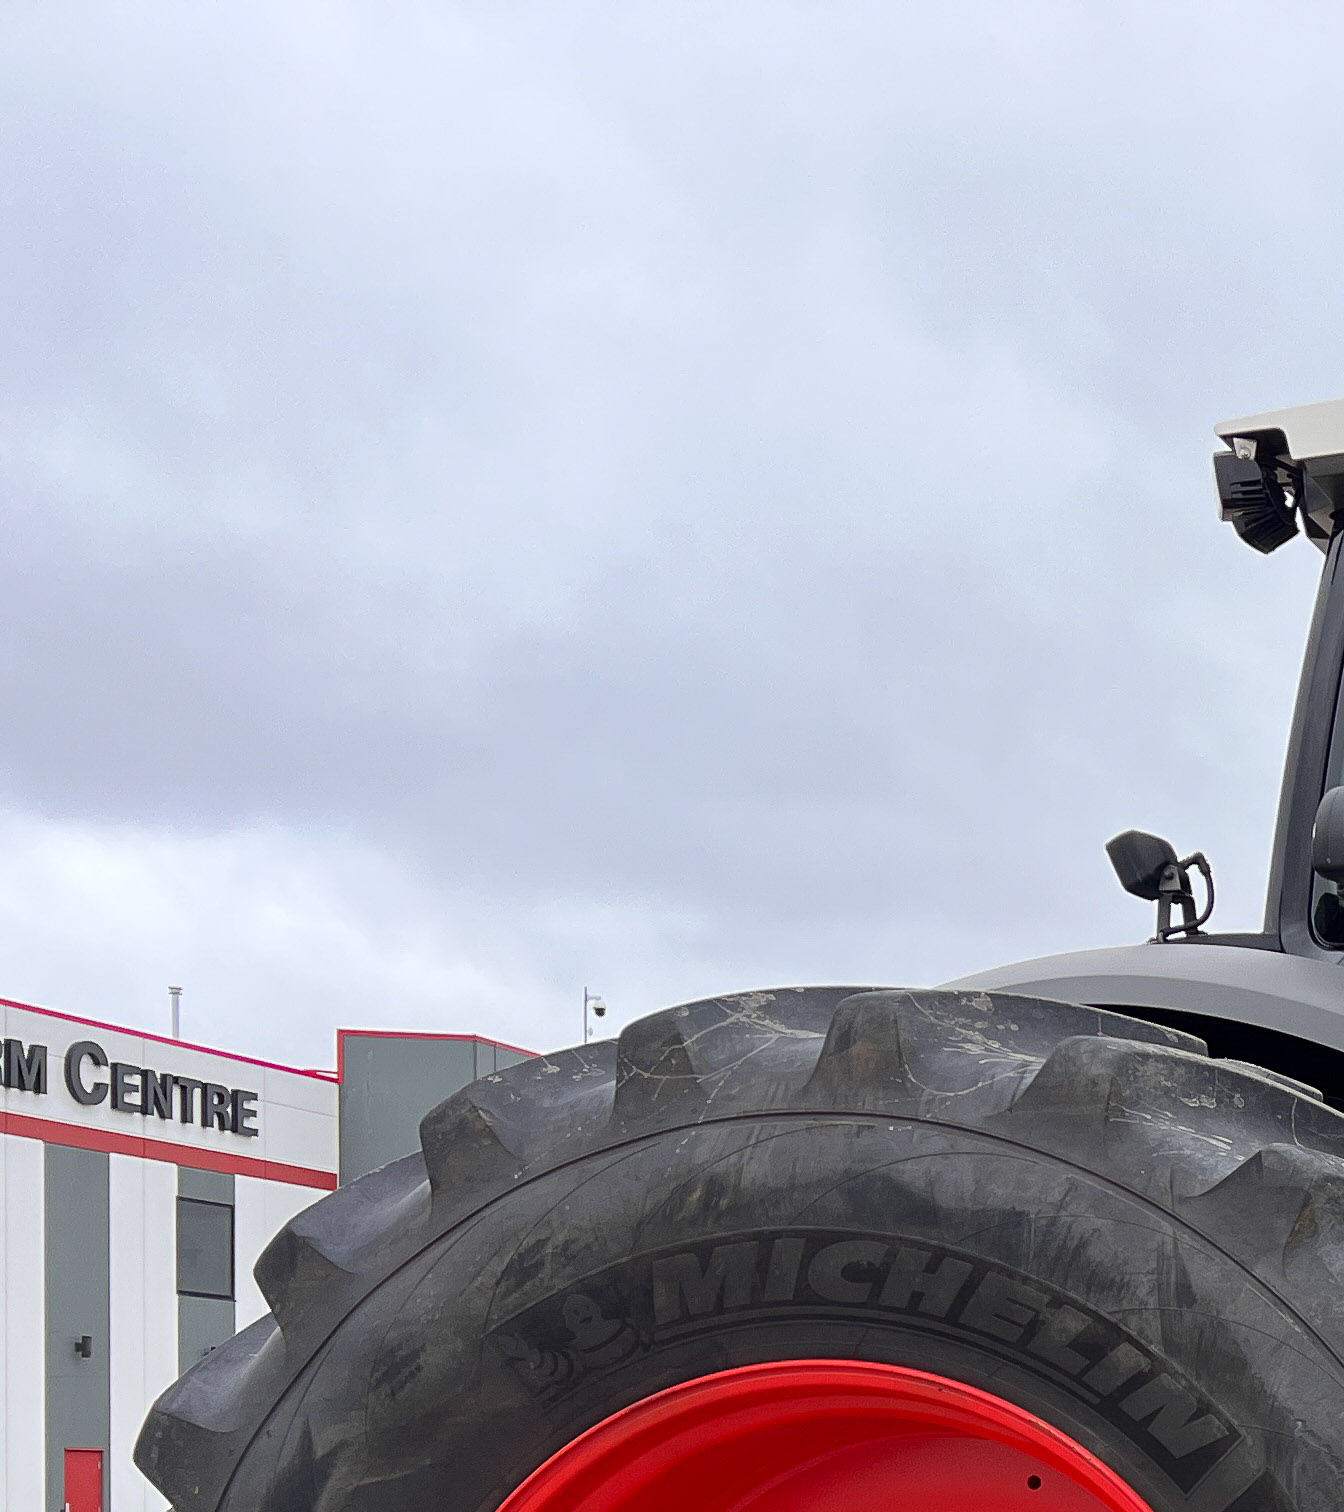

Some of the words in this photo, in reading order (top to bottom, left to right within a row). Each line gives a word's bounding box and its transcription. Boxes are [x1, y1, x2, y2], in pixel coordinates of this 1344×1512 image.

[0, 1038, 48, 1096] M
[63, 1040, 260, 1138] CENTRE
[652, 1236, 1229, 1462] MICHELIN
